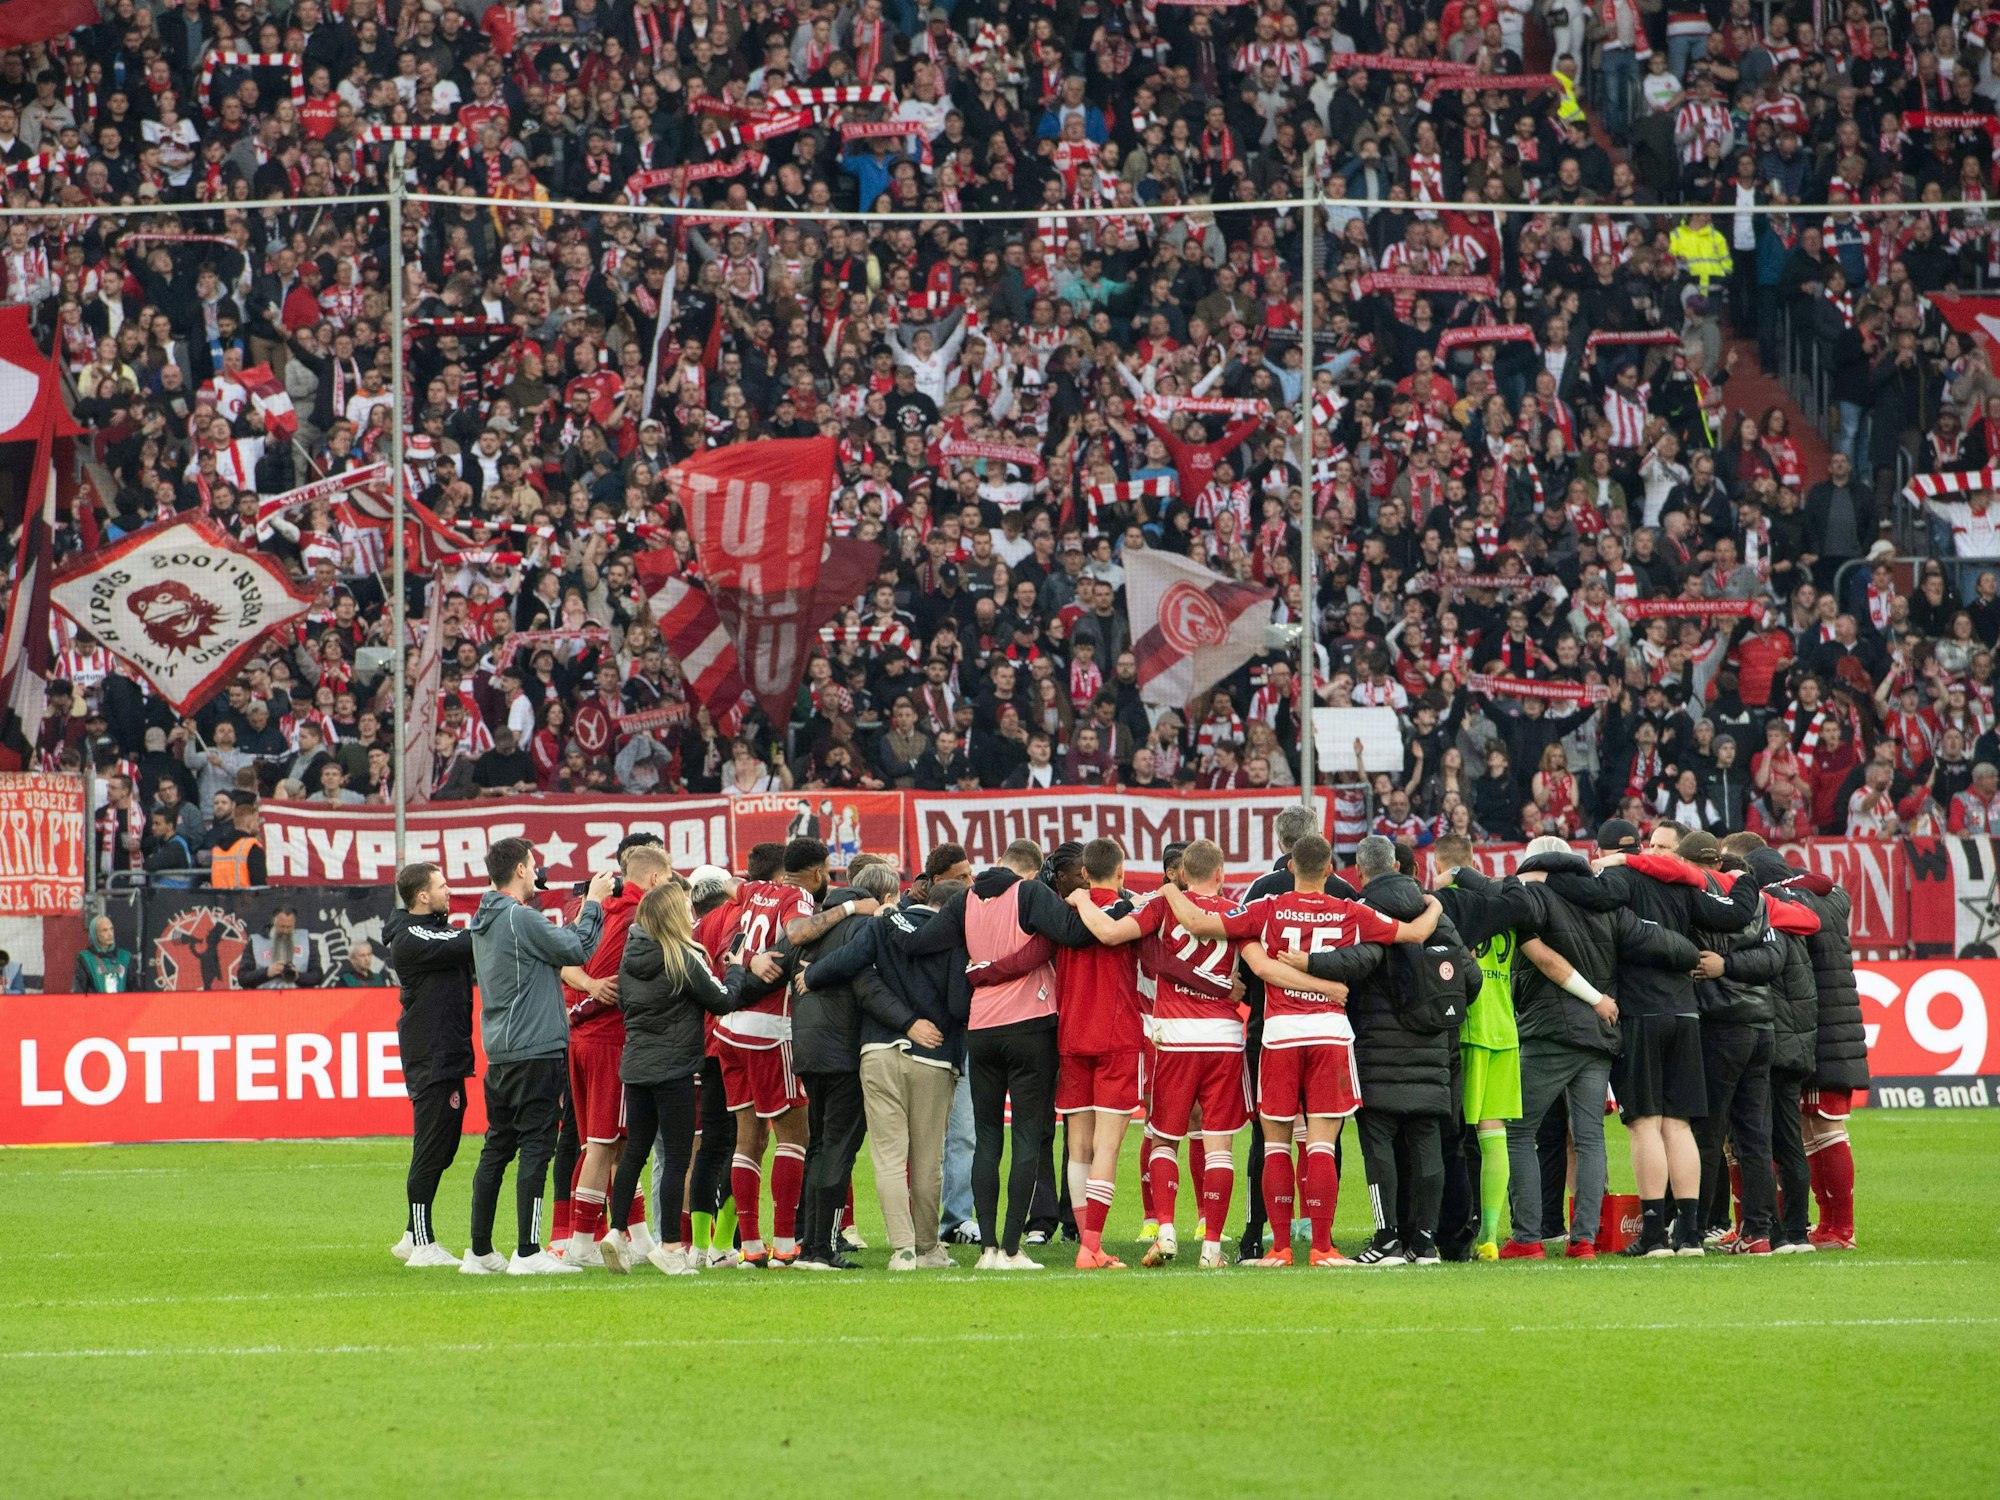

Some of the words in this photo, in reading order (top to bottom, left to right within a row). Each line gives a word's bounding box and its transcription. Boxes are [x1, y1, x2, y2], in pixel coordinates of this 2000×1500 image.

[735, 795, 800, 815] antira
[925, 804, 1317, 864] DANGERMOUT
[1275, 909, 1347, 923] DÜSSELDORF
[1171, 922, 1229, 972] 22
[1280, 926, 1343, 955] 15
[20, 1031, 410, 1106] LOTTERIE
[1879, 1087, 1926, 1109] me
[1933, 1079, 1990, 1108] and
[1168, 1180, 1179, 1191] F9
